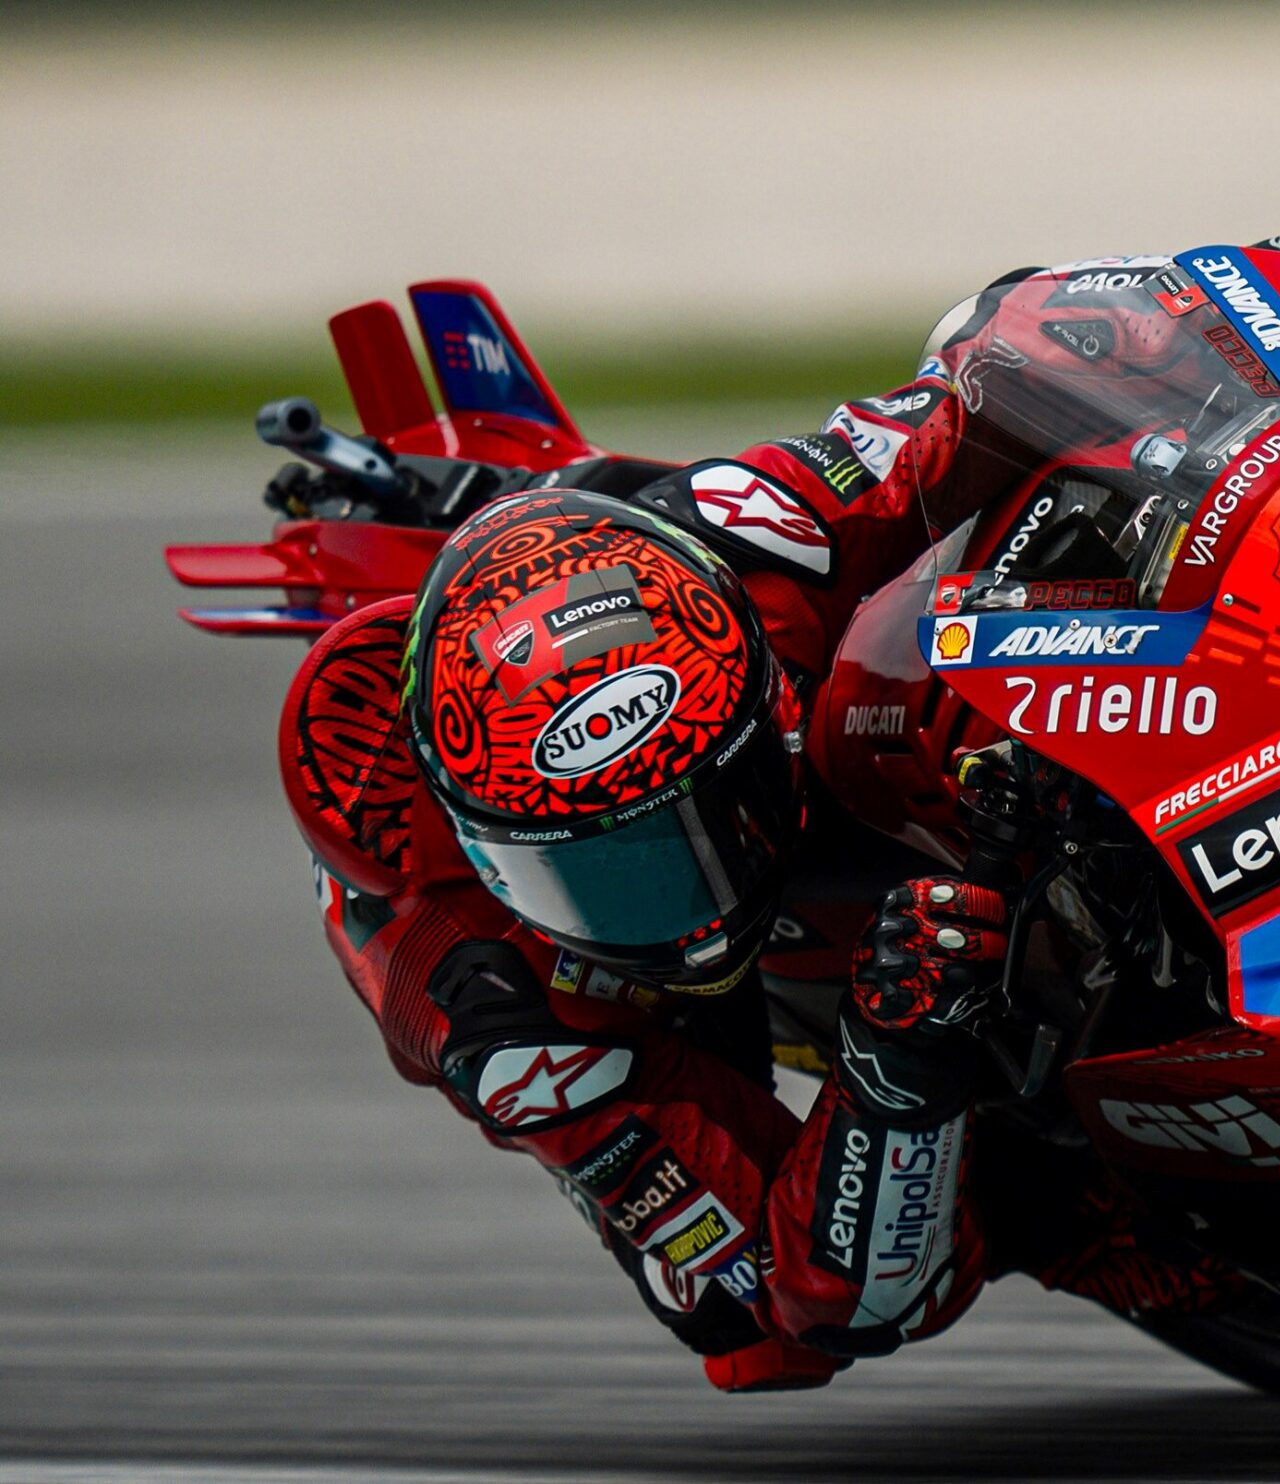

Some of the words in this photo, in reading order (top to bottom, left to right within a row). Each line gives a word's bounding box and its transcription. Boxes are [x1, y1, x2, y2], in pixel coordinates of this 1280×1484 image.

[1066, 271, 1155, 295] novo
[1024, 579, 1140, 611] PECCO
[550, 595, 632, 629] Lenovo
[496, 622, 530, 651] DUCATI
[544, 683, 671, 762] SUOMY
[844, 705, 906, 735] DUCATI
[716, 719, 758, 767] CARRERA
[509, 829, 573, 842] CARRERA
[826, 1128, 870, 1269] Lenovo
[875, 1122, 943, 1281] UnipolSa
